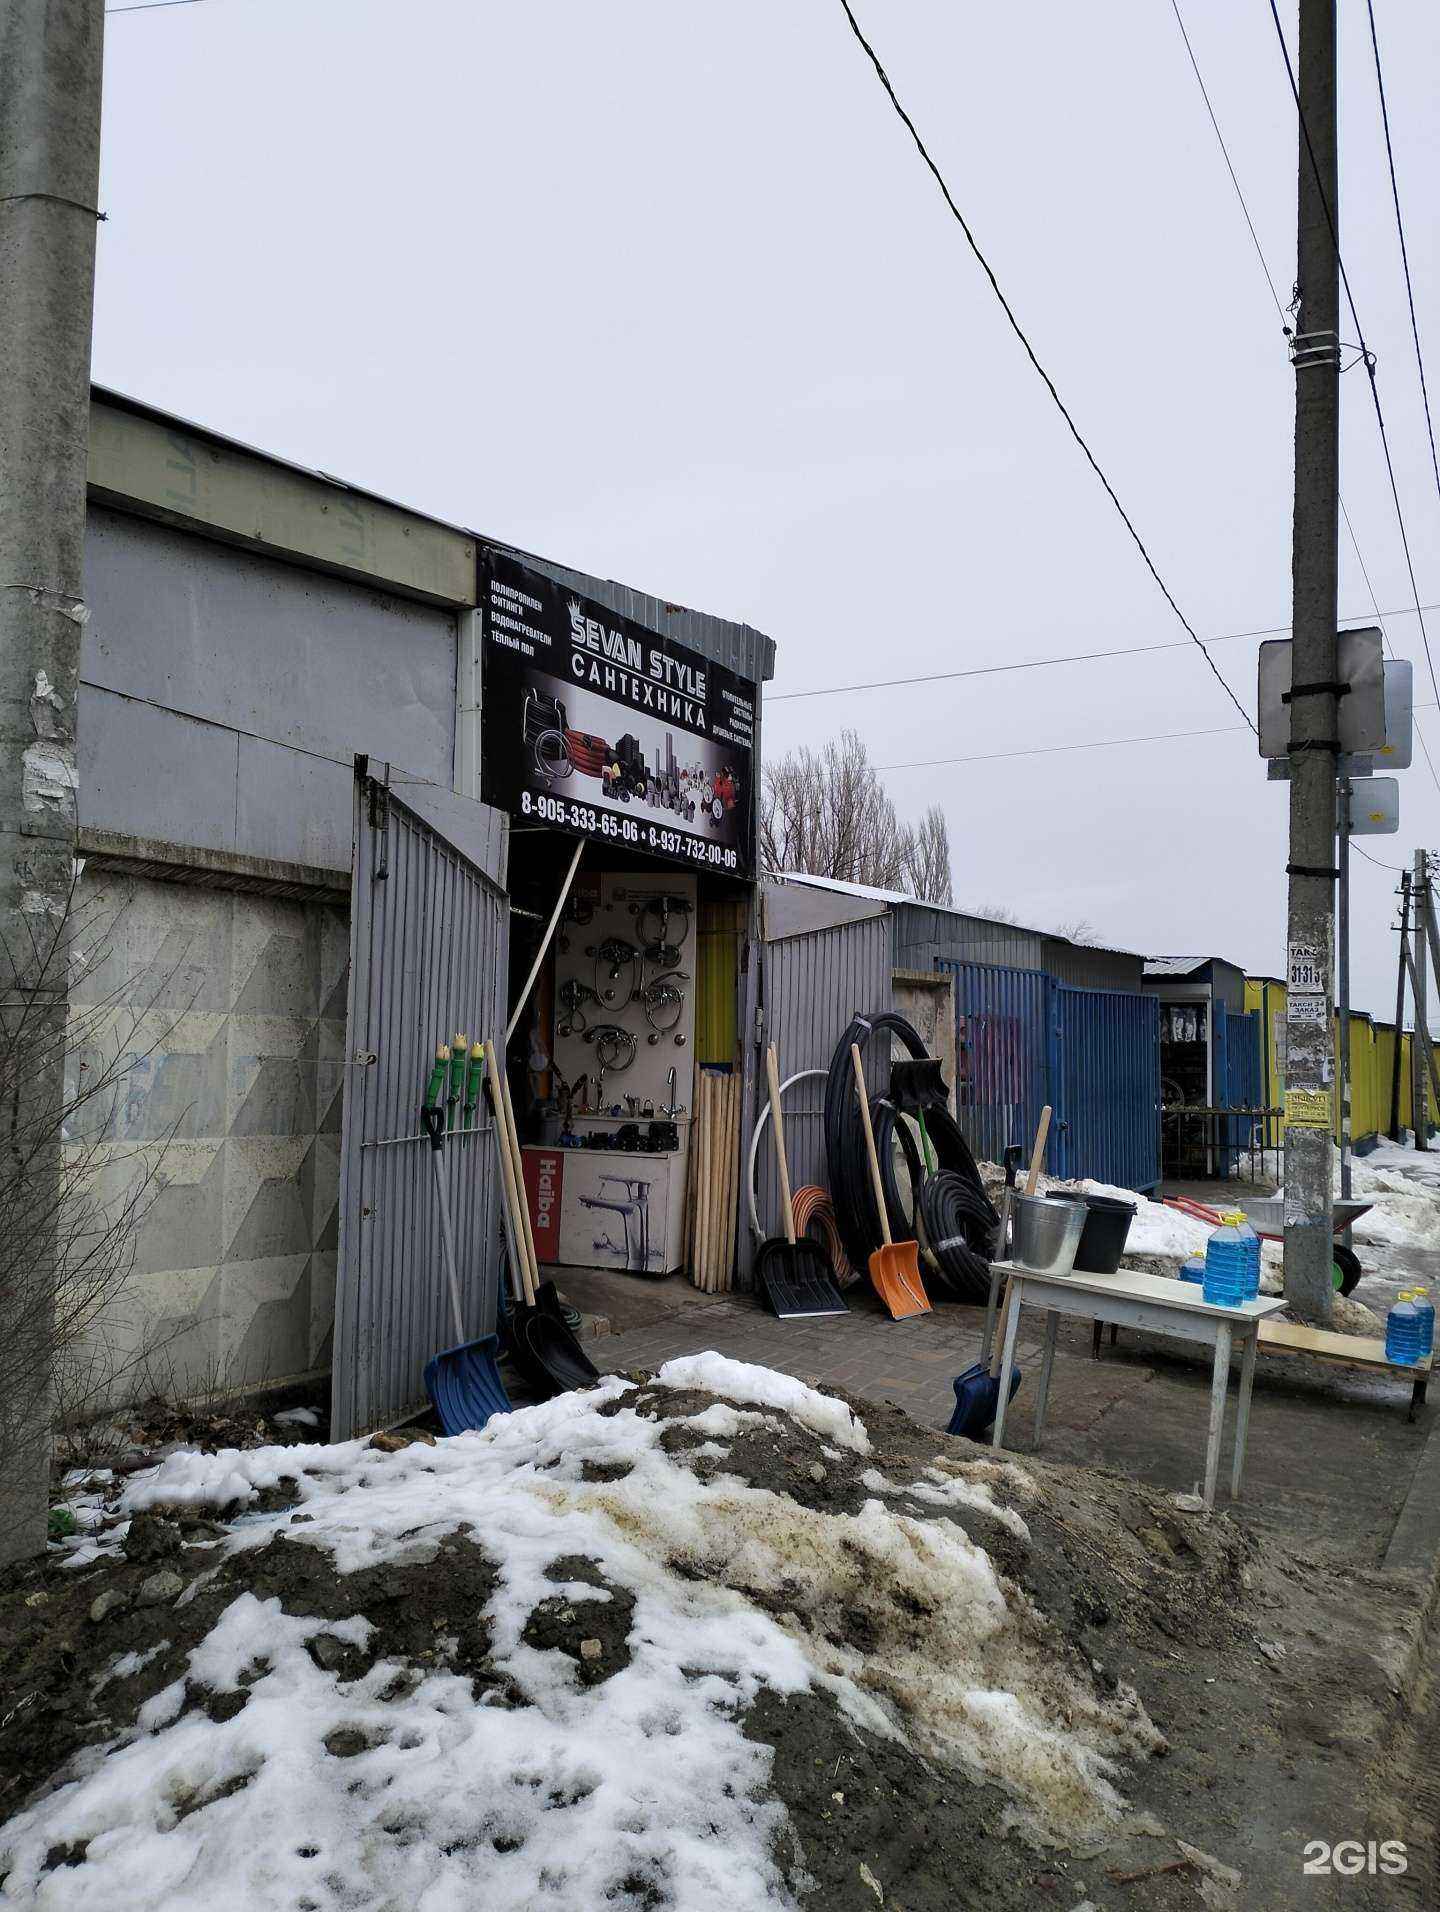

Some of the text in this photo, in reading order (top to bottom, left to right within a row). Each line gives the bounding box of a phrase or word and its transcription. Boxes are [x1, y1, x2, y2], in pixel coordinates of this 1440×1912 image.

[490, 580, 543, 612] ПОЛИПРОПИЛЕН
[491, 594, 523, 616] ФИТИНГИ
[491, 611, 552, 646] ВОДОНАГРЕВАТЕЛИ
[520, 641, 535, 657] ПОЛ
[571, 615, 706, 700] SEVAN STYLE
[571, 653, 706, 729] САНТЕХНИКА
[521, 791, 737, 869] 8-905-333-65-06 8-937-732-00-06
[537, 1159, 556, 1229] Haiba
